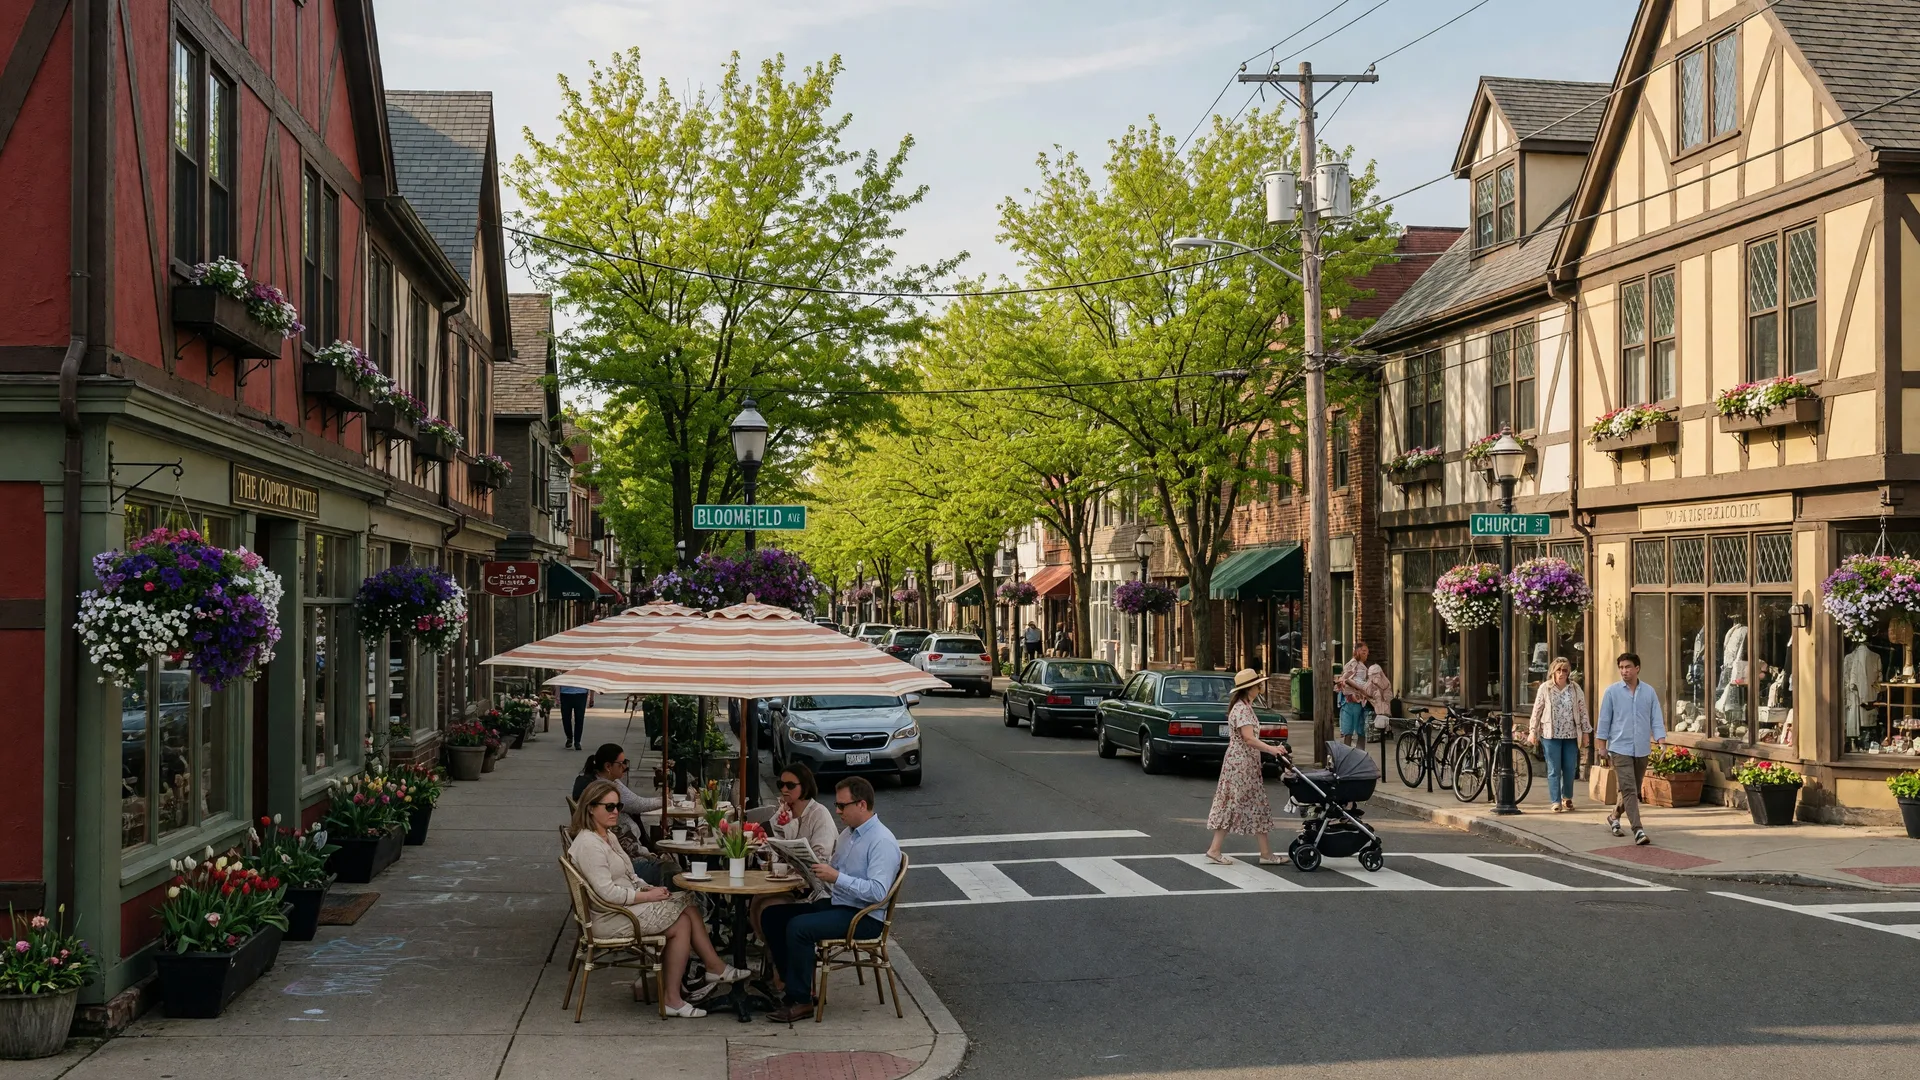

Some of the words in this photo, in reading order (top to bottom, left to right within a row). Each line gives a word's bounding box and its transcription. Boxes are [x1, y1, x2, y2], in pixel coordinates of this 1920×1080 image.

[238, 472, 257, 500] THE
[260, 477, 290, 508] COPPER
[292, 486, 317, 514] KETTLE
[697, 508, 782, 526] BLOOMFIELD
[788, 513, 801, 523] AVE
[1476, 516, 1527, 533] CHURCH
[1535, 518, 1545, 528] ST
